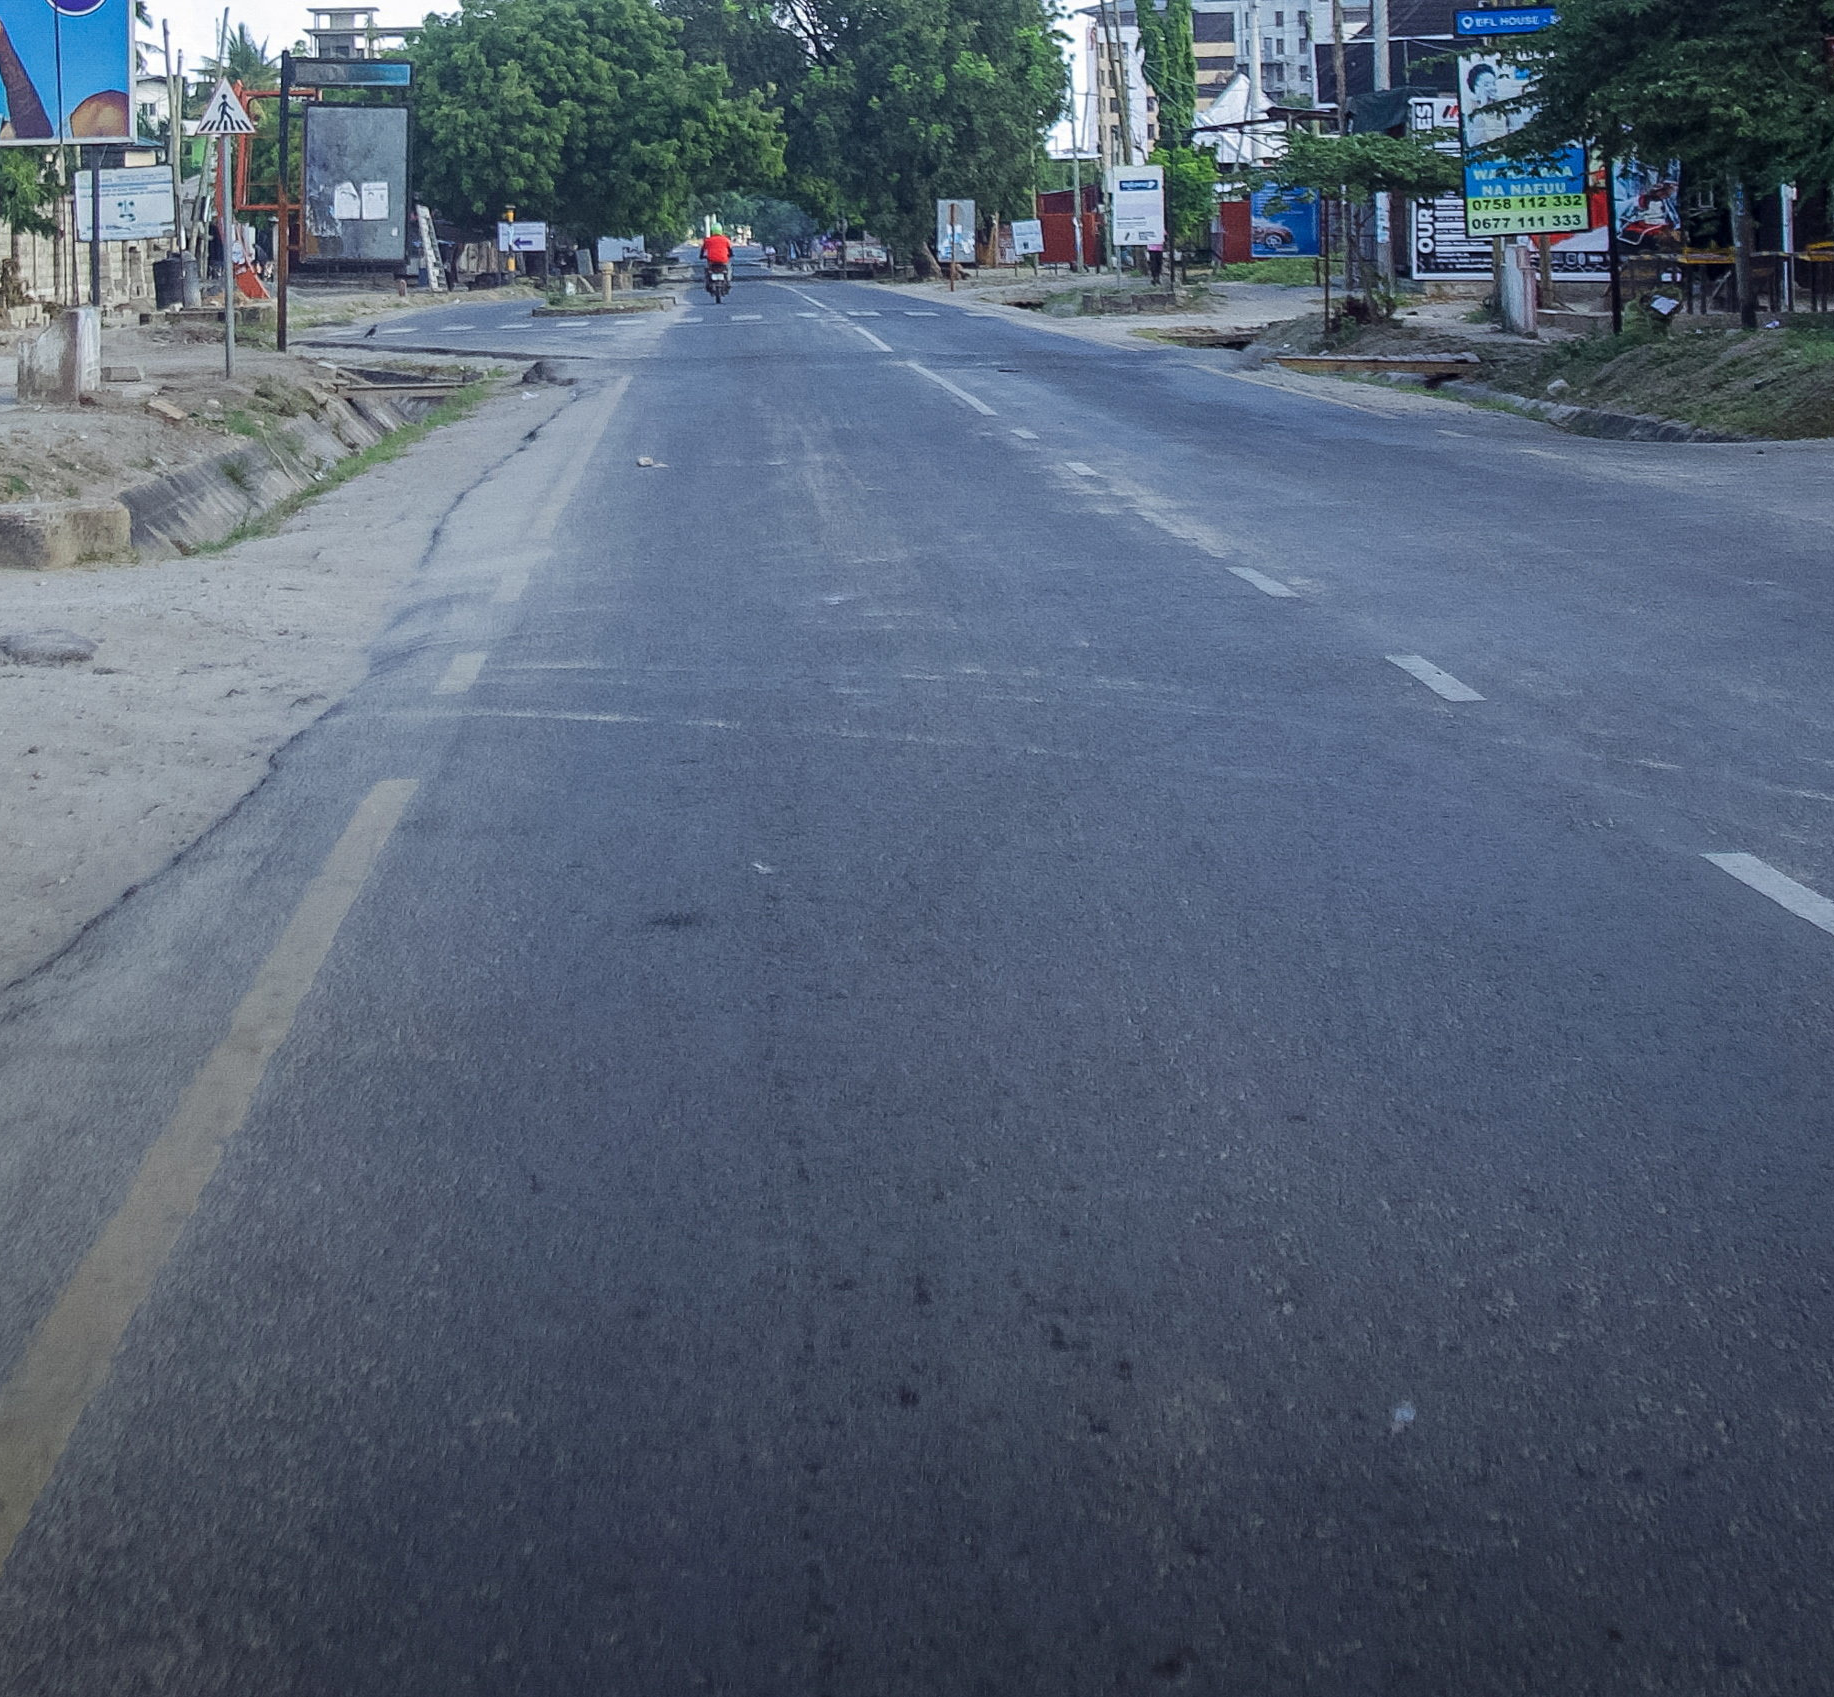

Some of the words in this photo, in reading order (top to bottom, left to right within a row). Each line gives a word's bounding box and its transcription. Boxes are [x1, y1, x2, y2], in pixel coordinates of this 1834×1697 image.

[1500, 15, 1540, 26] HOUSE
[1482, 185, 1506, 196] NA
[1510, 182, 1567, 196] NAFUU
[1472, 198, 1512, 211] 0758
[1519, 196, 1547, 209] 112
[1552, 194, 1582, 207] 332
[1472, 217, 1511, 230] 0677
[1518, 216, 1545, 228] 111
[1552, 214, 1582, 227] 333
[1418, 208, 1435, 254] OUR
